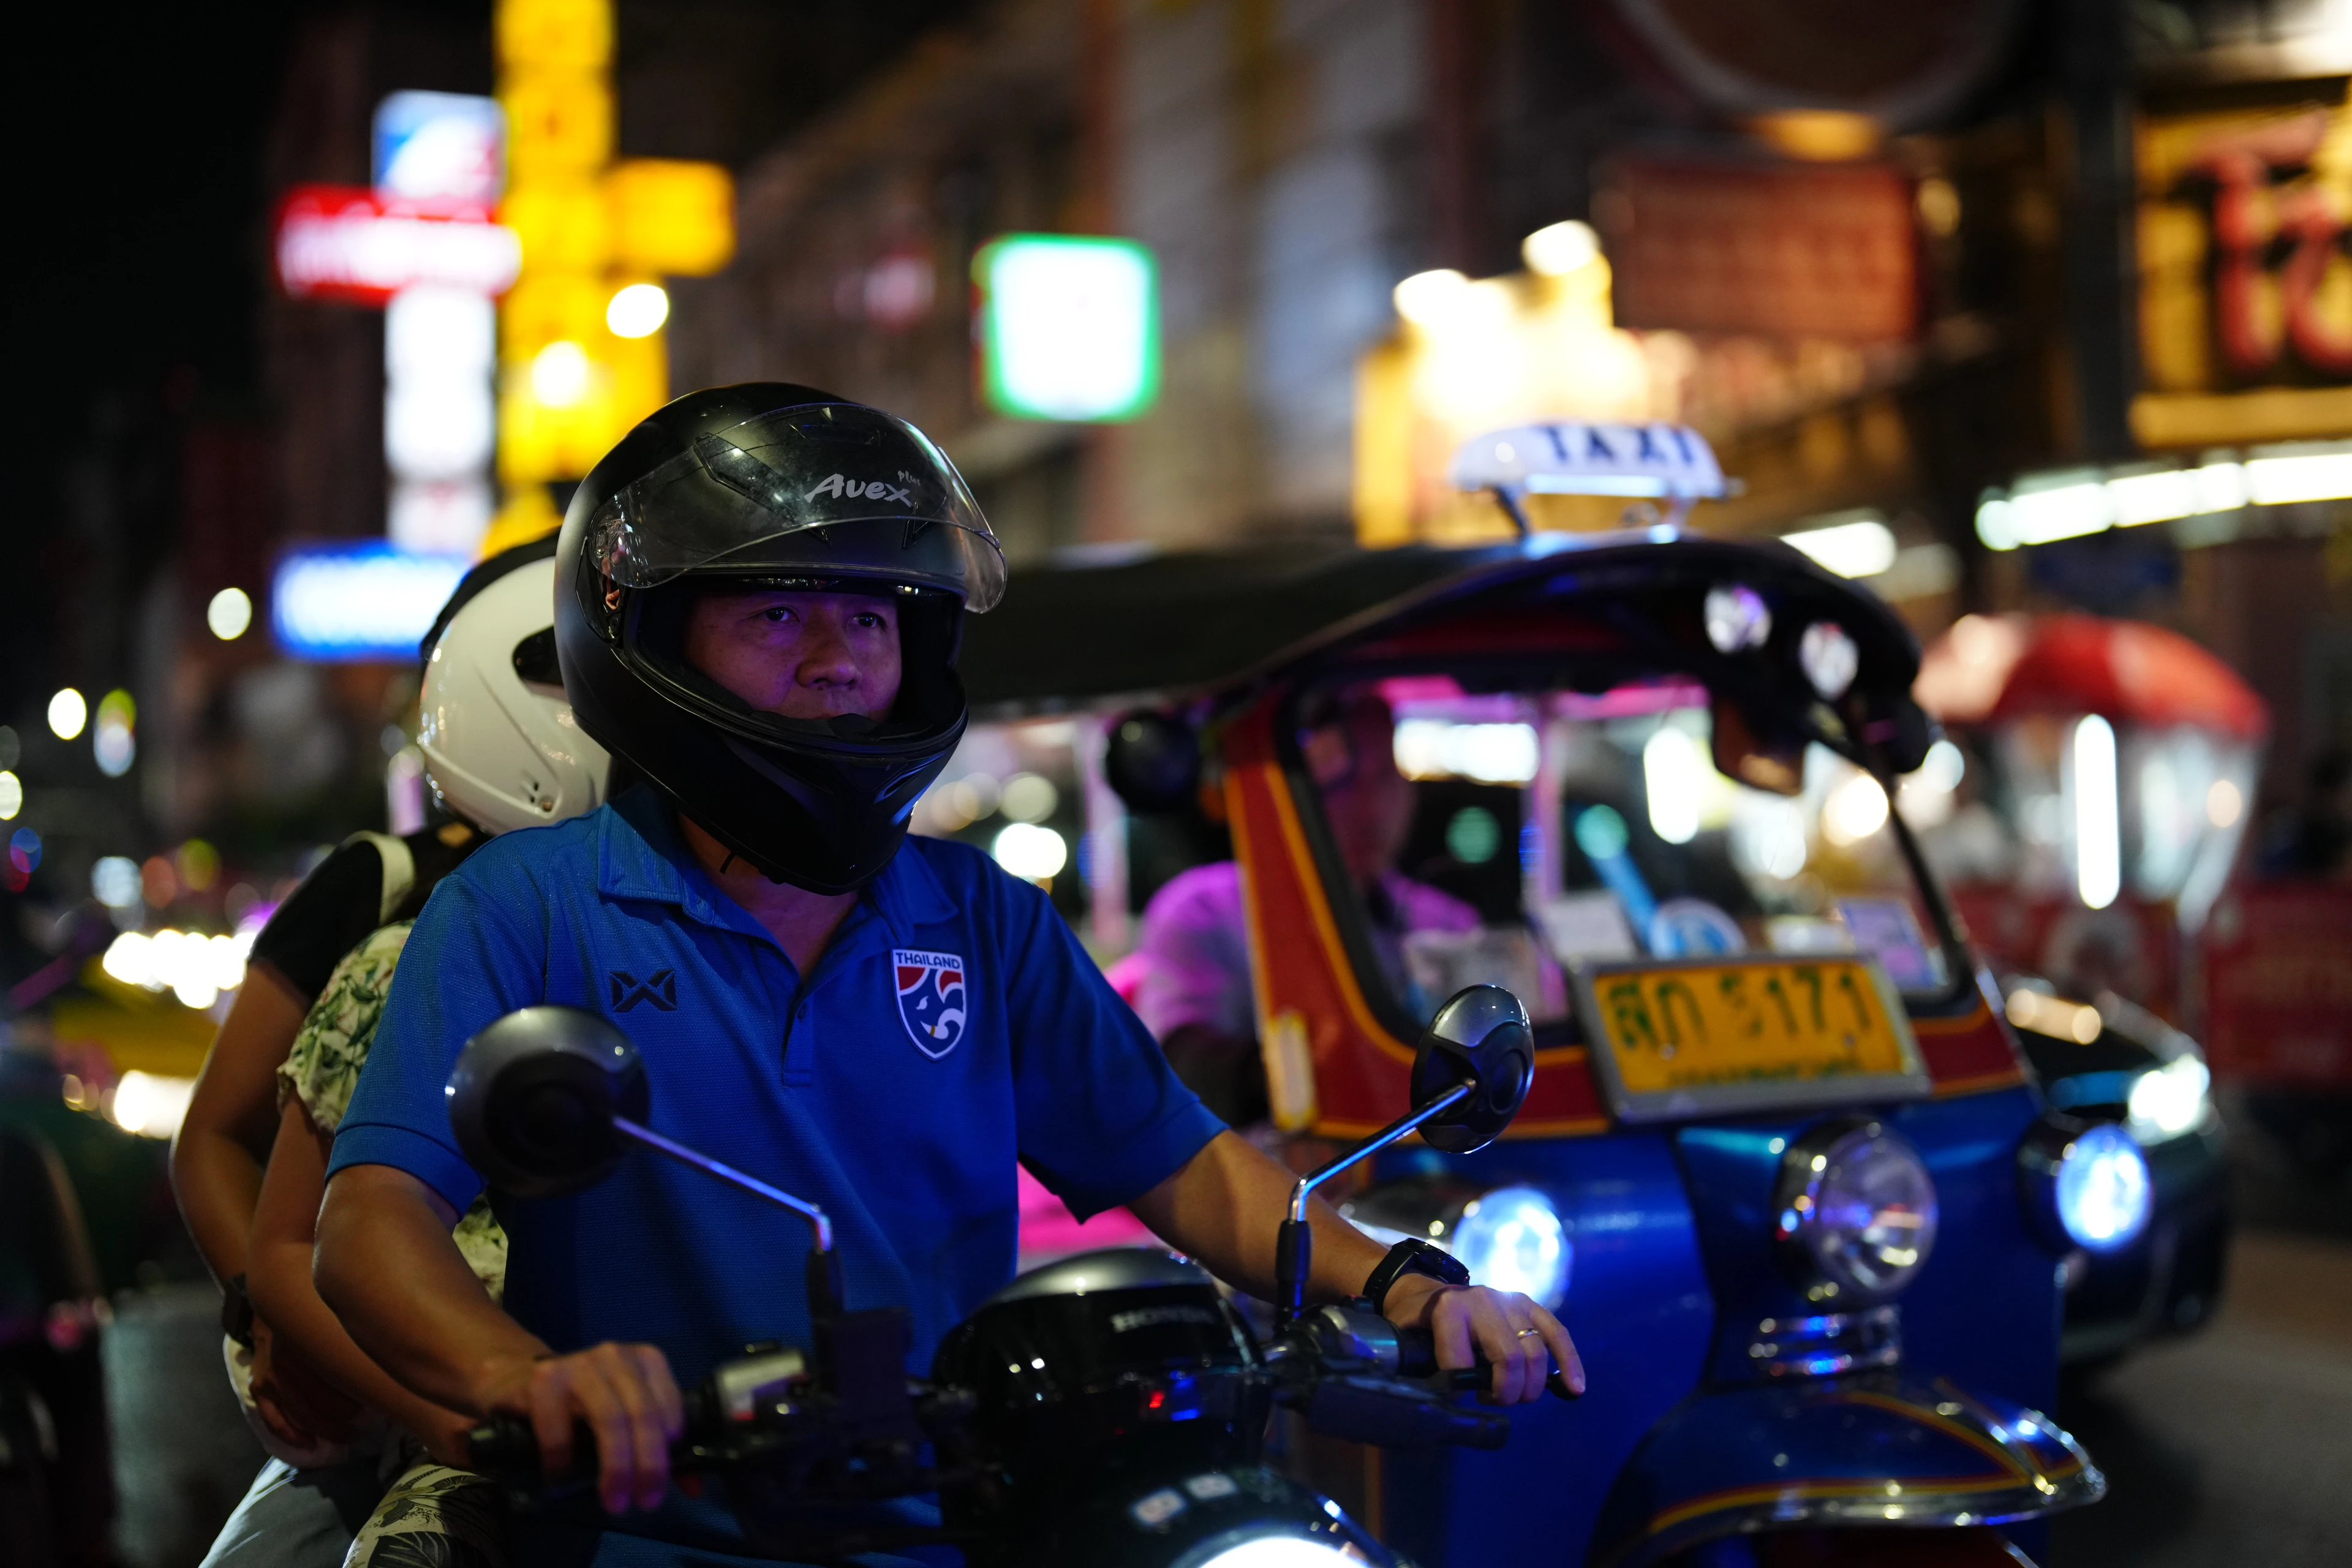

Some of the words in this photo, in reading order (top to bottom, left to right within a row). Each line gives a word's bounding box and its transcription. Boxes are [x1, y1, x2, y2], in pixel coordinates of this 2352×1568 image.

[1531, 424, 1697, 463] TAXI
[804, 473, 913, 508] Avex
[895, 952, 960, 970] THAILAND
